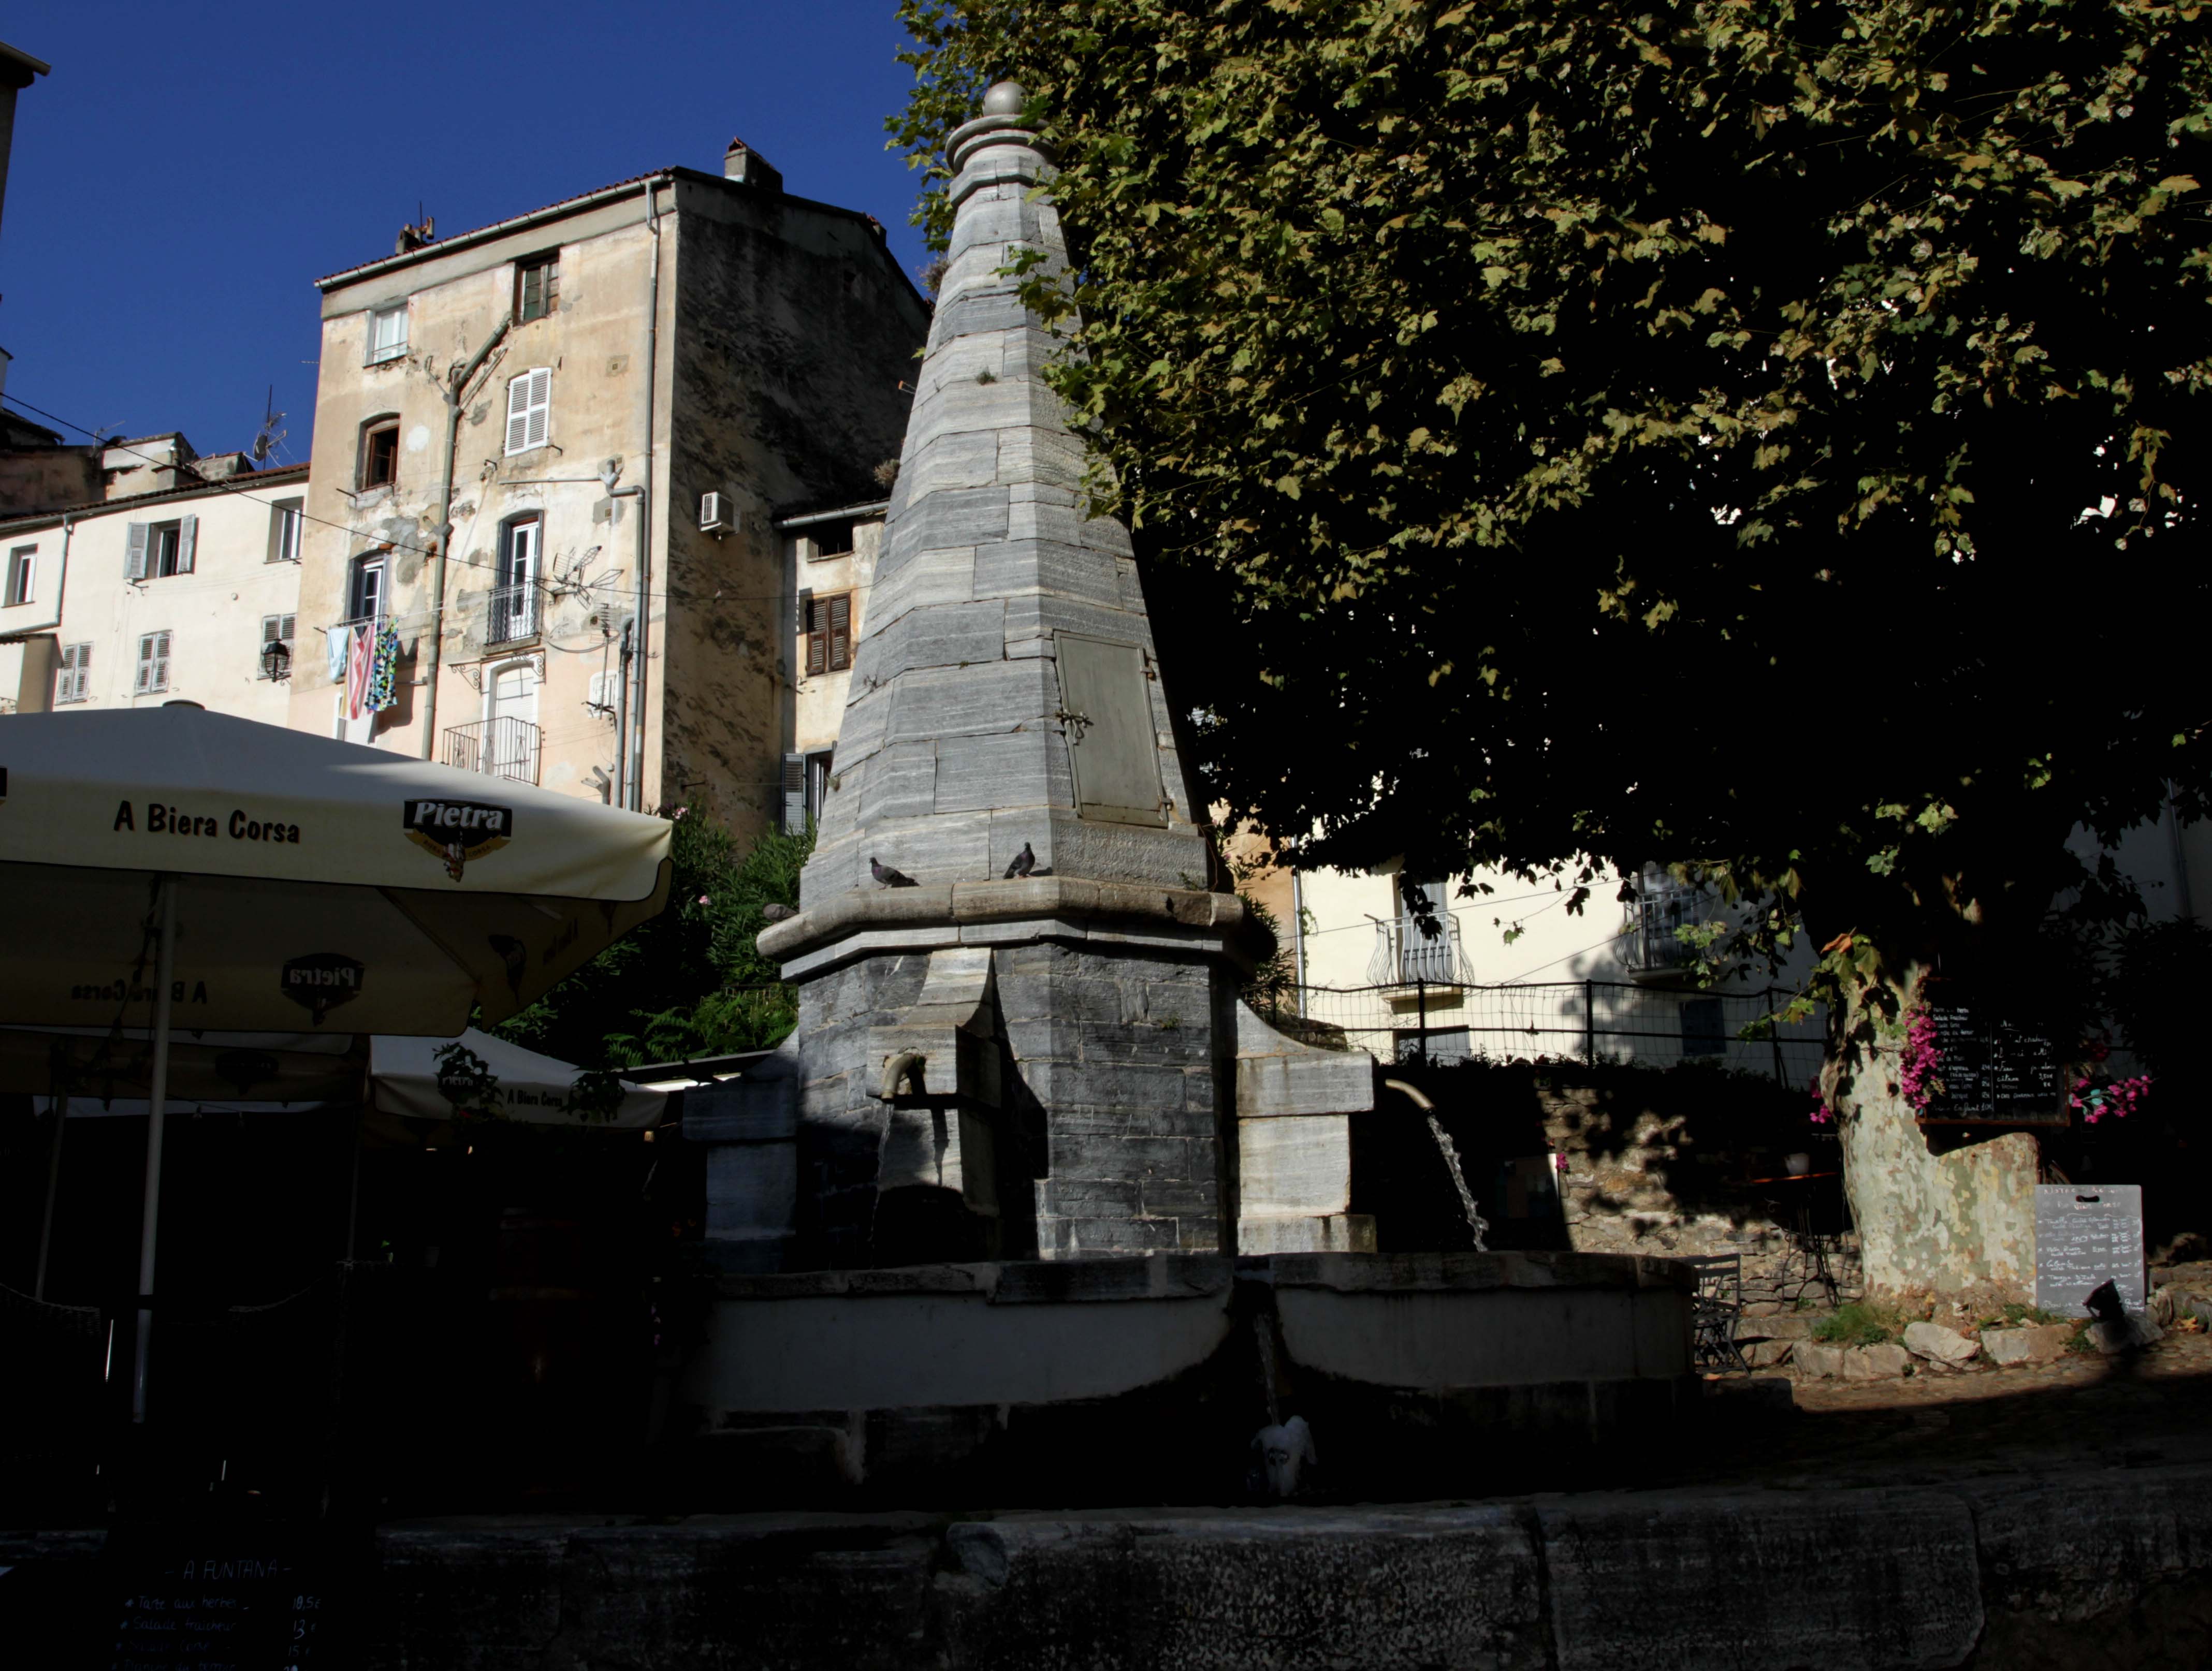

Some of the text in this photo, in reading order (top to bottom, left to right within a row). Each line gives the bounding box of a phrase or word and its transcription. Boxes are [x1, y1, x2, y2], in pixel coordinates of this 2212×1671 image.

[114, 800, 299, 843] A Biera Corsa
[412, 802, 505, 831] Pietra
[507, 1089, 514, 1104] A
[182, 1558, 279, 1580] A FUNTANA
[137, 1594, 167, 1611] Tarte
[173, 1597, 195, 1611] aux
[132, 1615, 178, 1631] Salade
